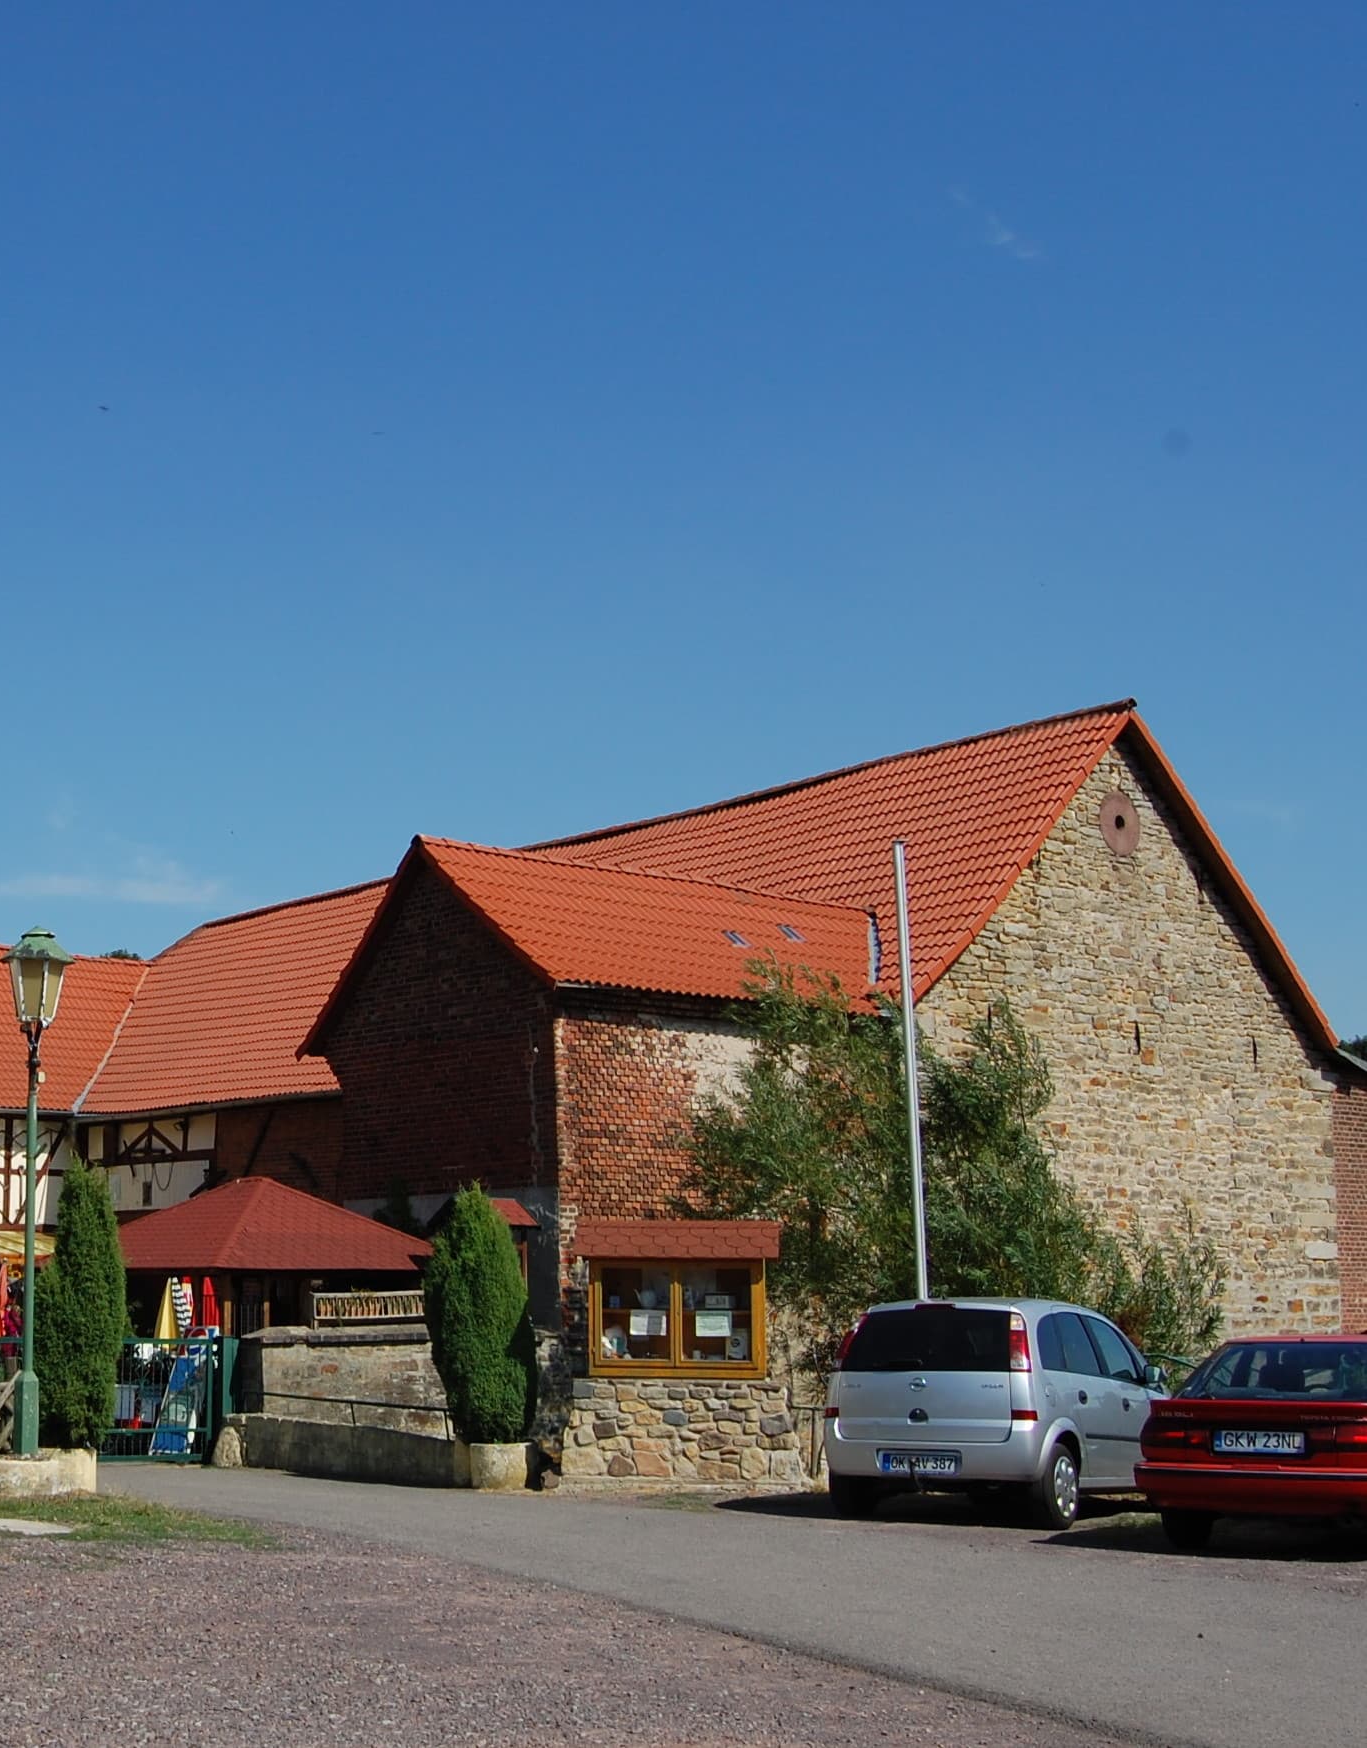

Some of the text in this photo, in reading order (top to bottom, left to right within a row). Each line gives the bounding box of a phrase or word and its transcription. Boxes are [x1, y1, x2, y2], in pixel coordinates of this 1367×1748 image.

[1224, 1432, 1302, 1449] GKW 23NL
[890, 1456, 906, 1469] OK
[931, 1457, 954, 1470] 387
